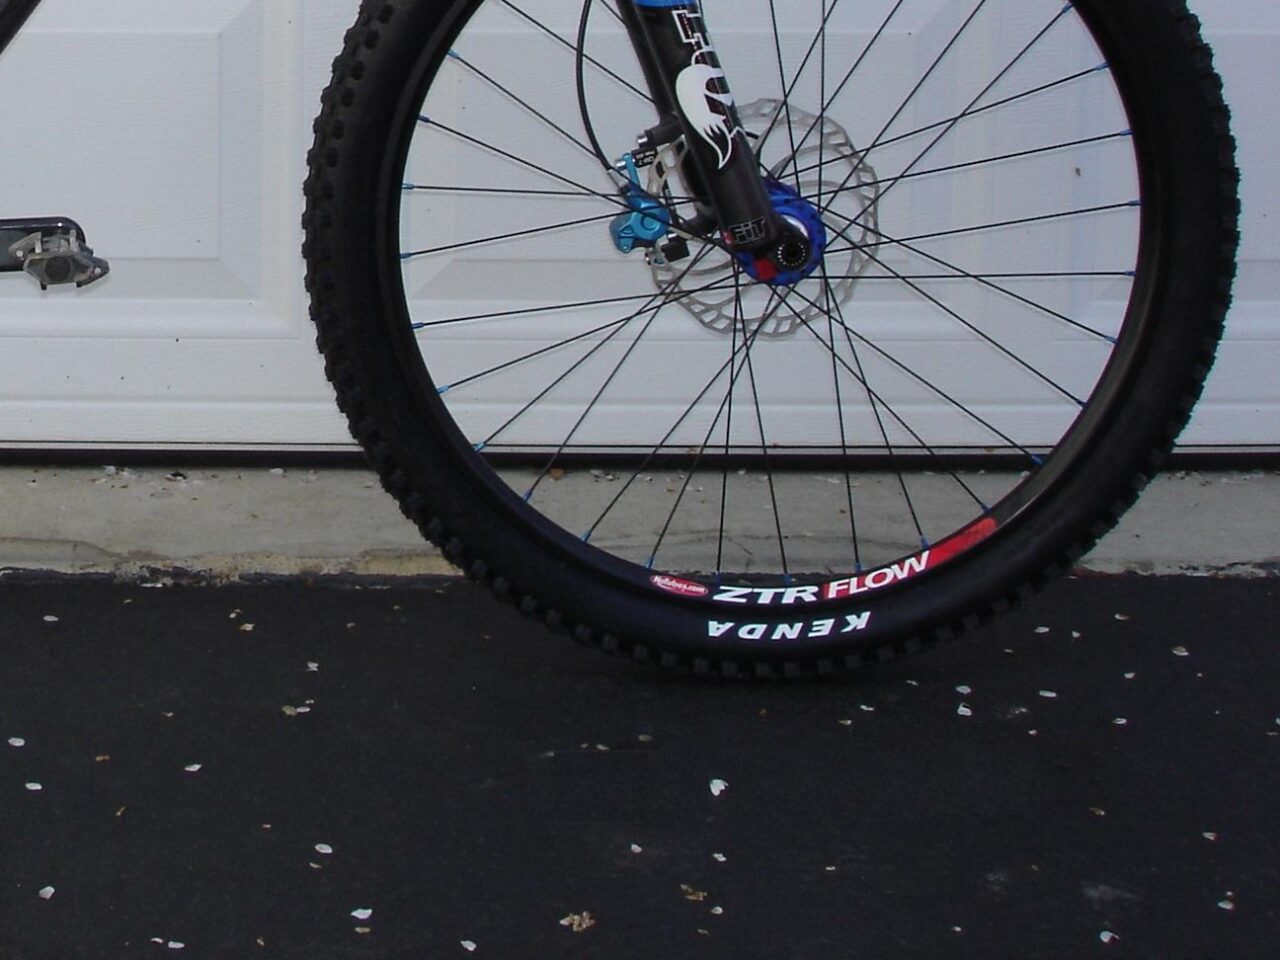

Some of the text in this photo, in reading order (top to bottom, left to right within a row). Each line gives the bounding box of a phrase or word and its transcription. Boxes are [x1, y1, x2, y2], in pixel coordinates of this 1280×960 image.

[712, 585, 820, 604] ZTR
[826, 550, 931, 599] FLOW
[707, 610, 872, 641] KENDA
